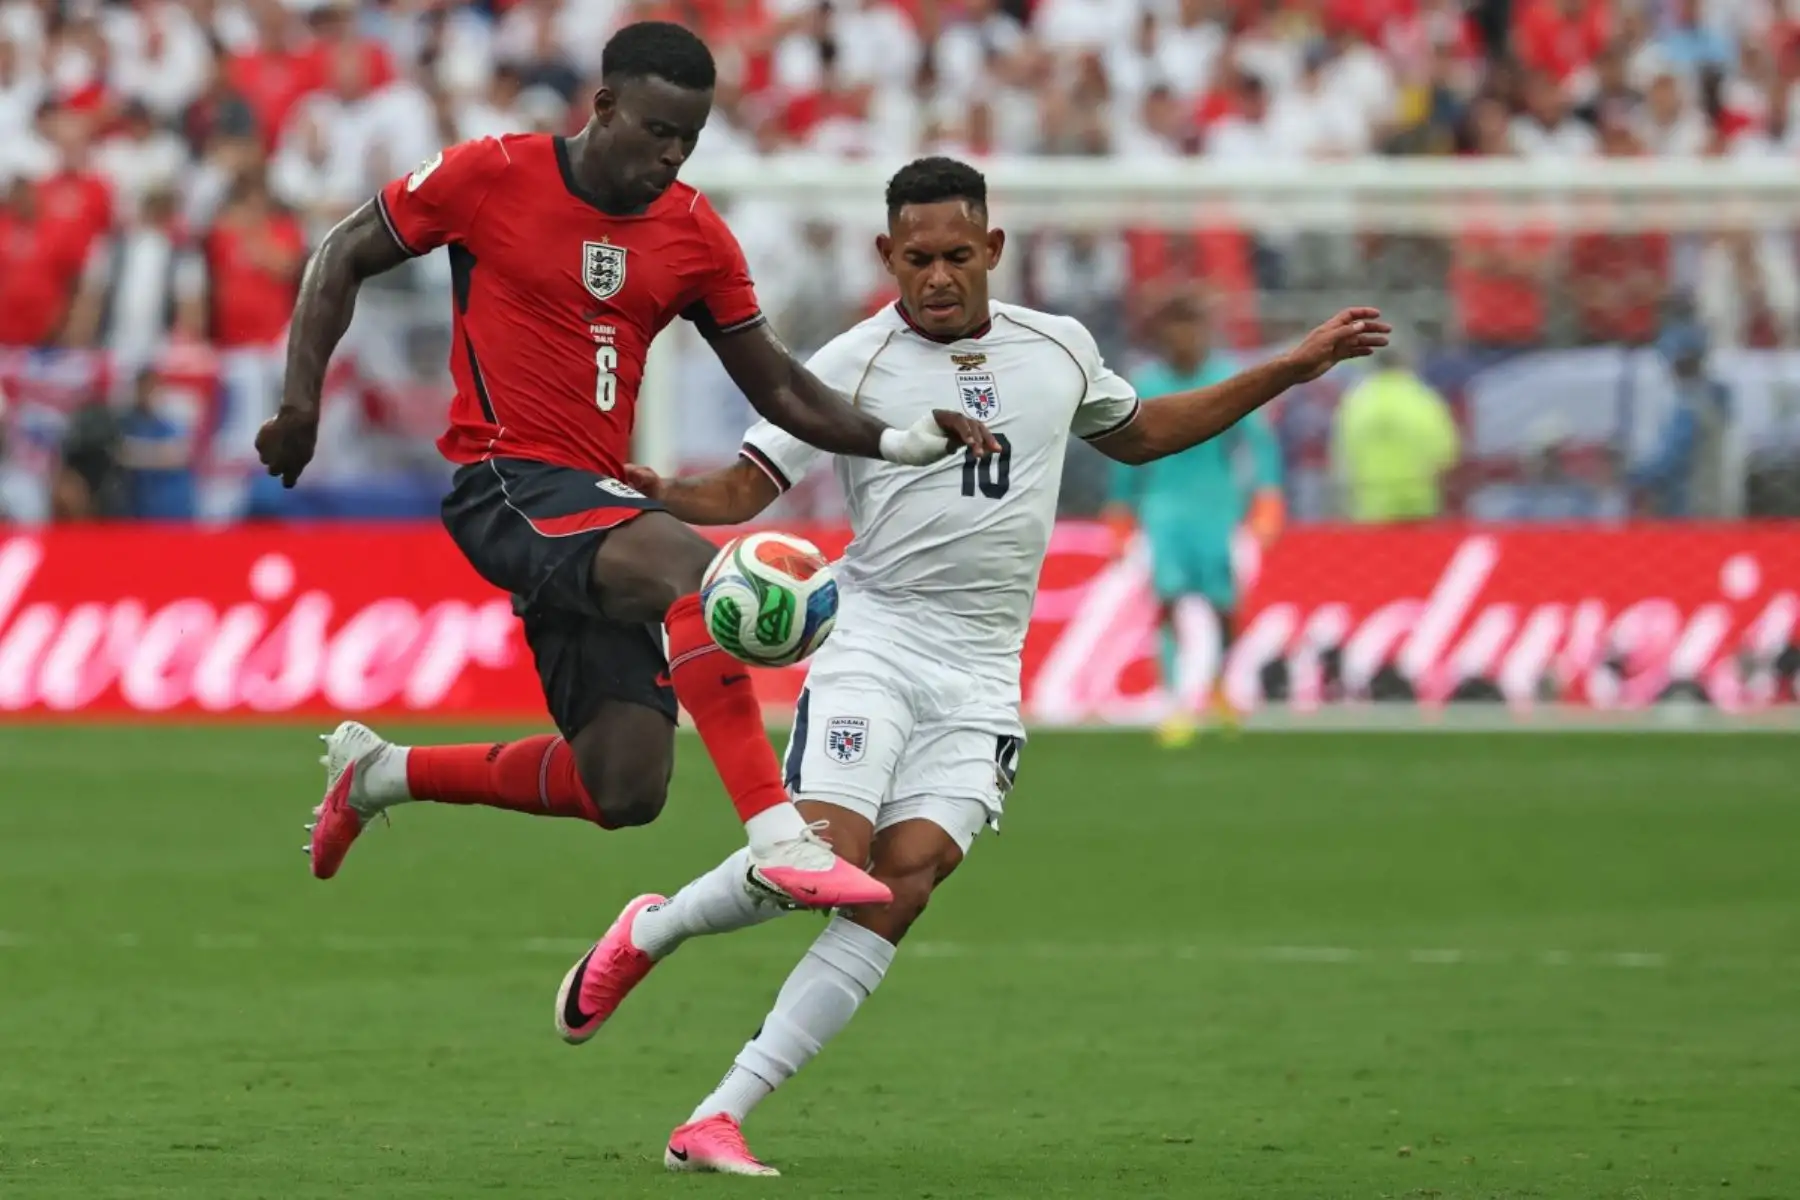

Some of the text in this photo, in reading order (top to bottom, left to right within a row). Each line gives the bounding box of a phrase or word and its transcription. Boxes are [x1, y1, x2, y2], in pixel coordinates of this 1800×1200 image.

[596, 346, 617, 412] 6
[961, 433, 1012, 500] 10
[0, 535, 517, 711] weiser
